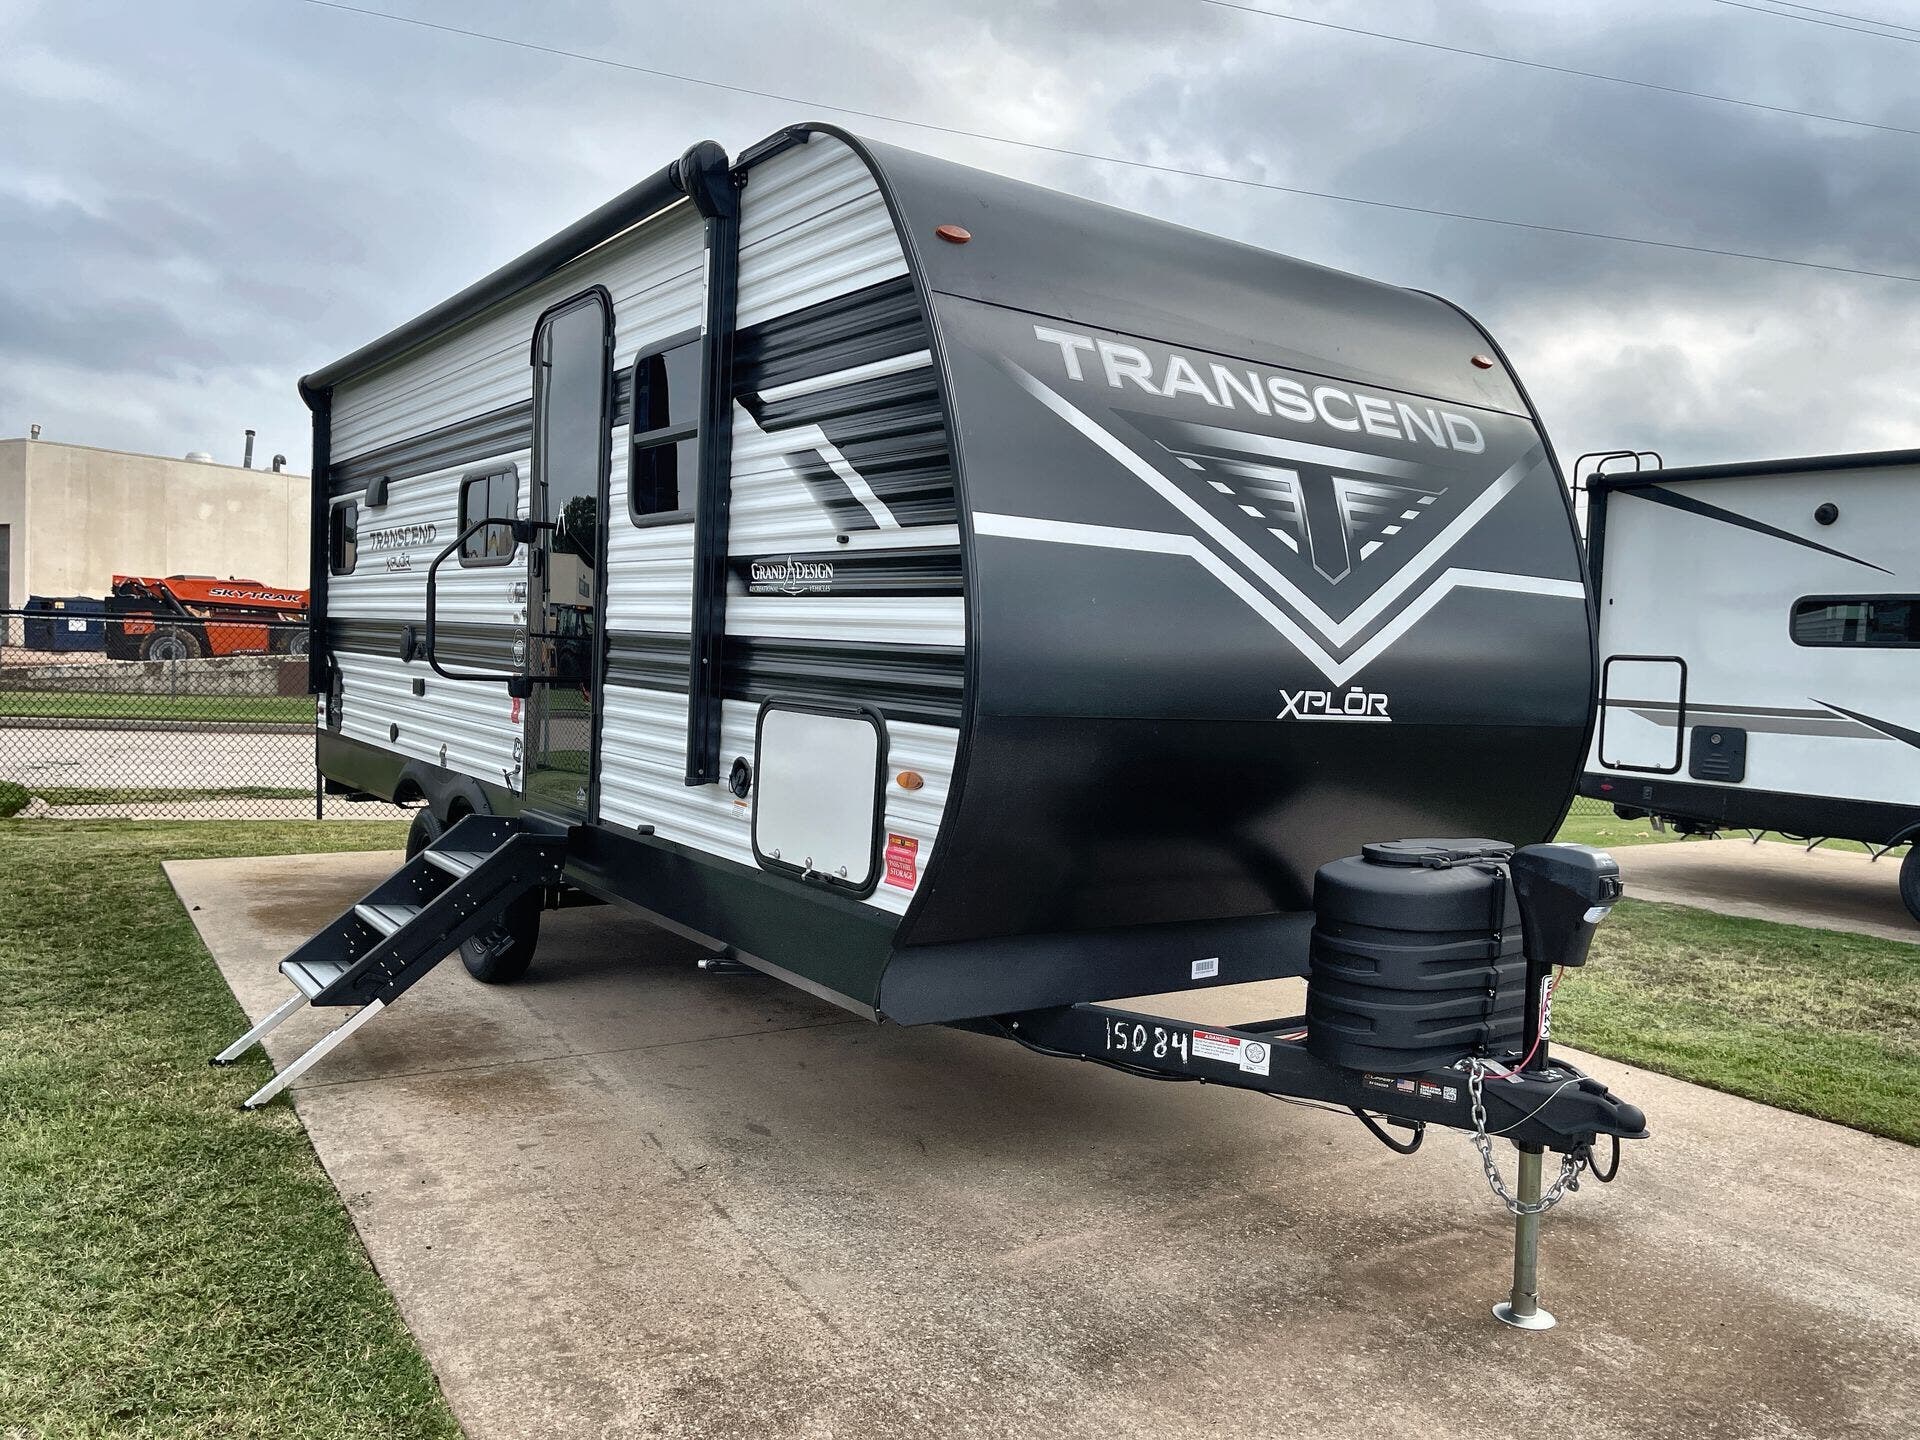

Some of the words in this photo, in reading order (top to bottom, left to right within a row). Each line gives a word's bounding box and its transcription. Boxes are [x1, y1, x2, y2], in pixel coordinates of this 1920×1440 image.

[1033, 324, 1486, 455] TRANSCEND
[369, 524, 437, 550] TRANSCEND
[751, 563, 787, 580] GRAND
[794, 561, 834, 579] DESIGN
[208, 588, 303, 603] SKYTRAK
[1106, 1017, 1188, 1064] 15084
